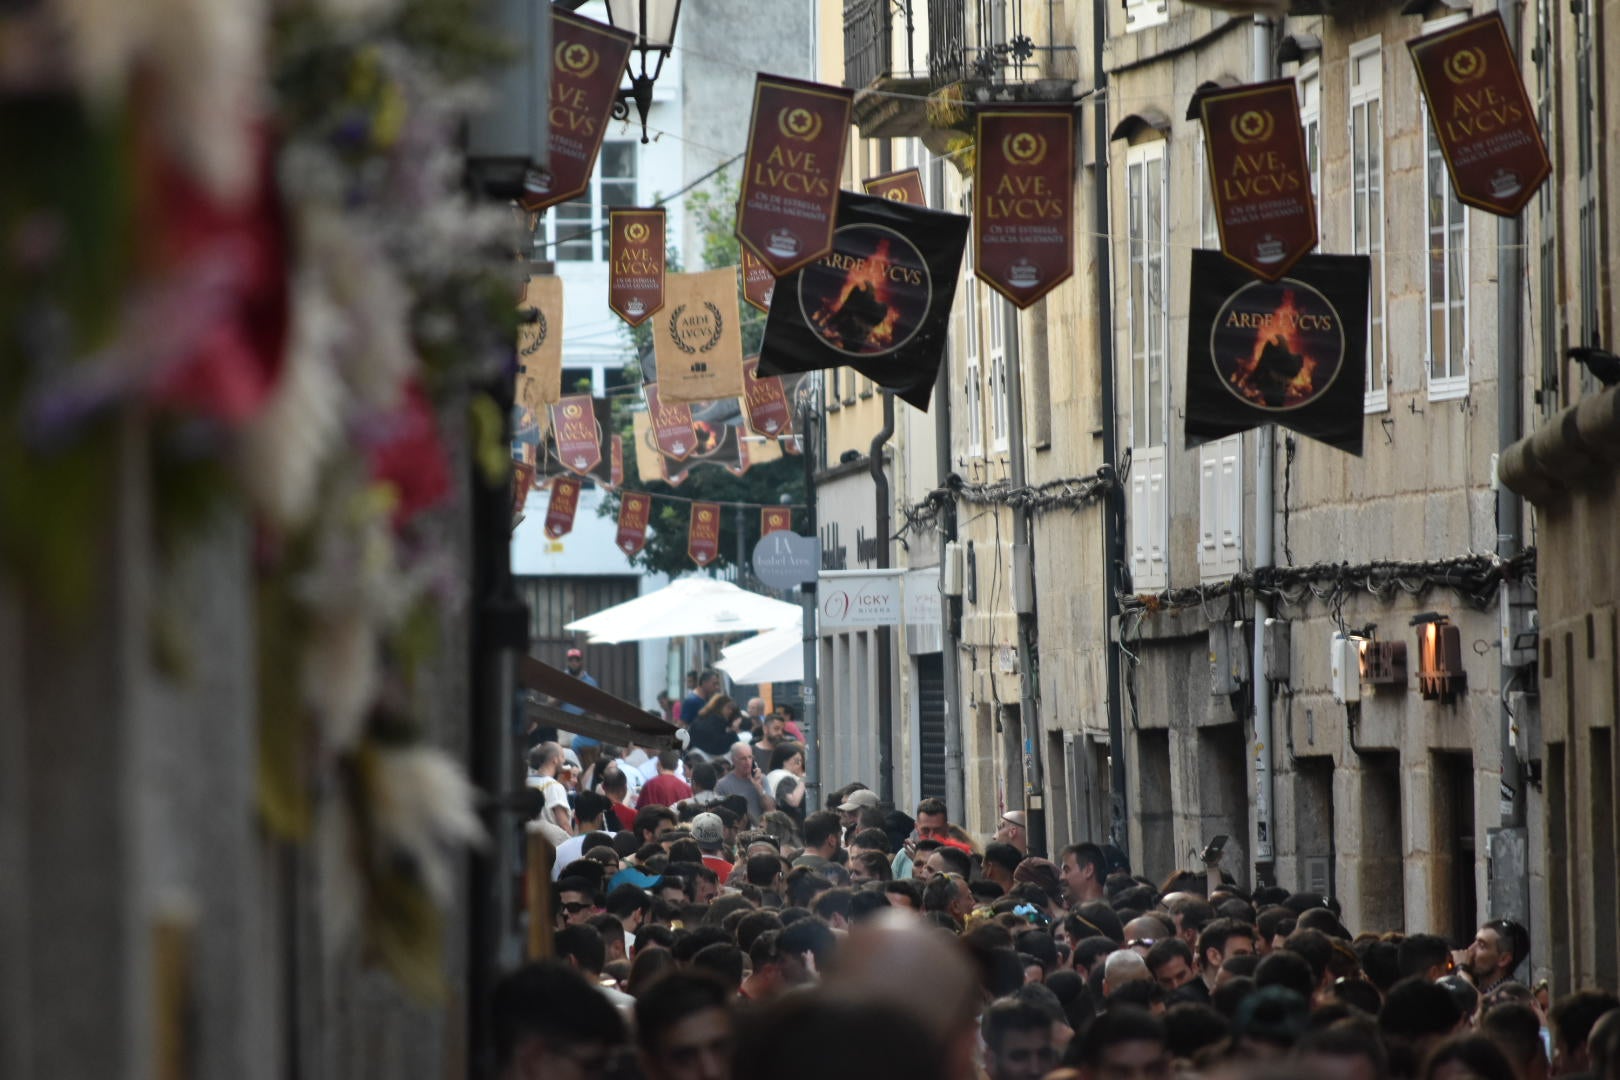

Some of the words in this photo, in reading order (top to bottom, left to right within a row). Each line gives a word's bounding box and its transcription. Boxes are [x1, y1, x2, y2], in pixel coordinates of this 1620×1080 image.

[549, 107, 597, 136] CVS
[1446, 103, 1522, 143] LVCVS
[754, 162, 830, 197] LVCVS
[1224, 170, 1300, 201] LVCVS
[986, 195, 1064, 219] LVCVS
[615, 260, 659, 275] LVCVS
[1226, 309, 1273, 329] ARDE
